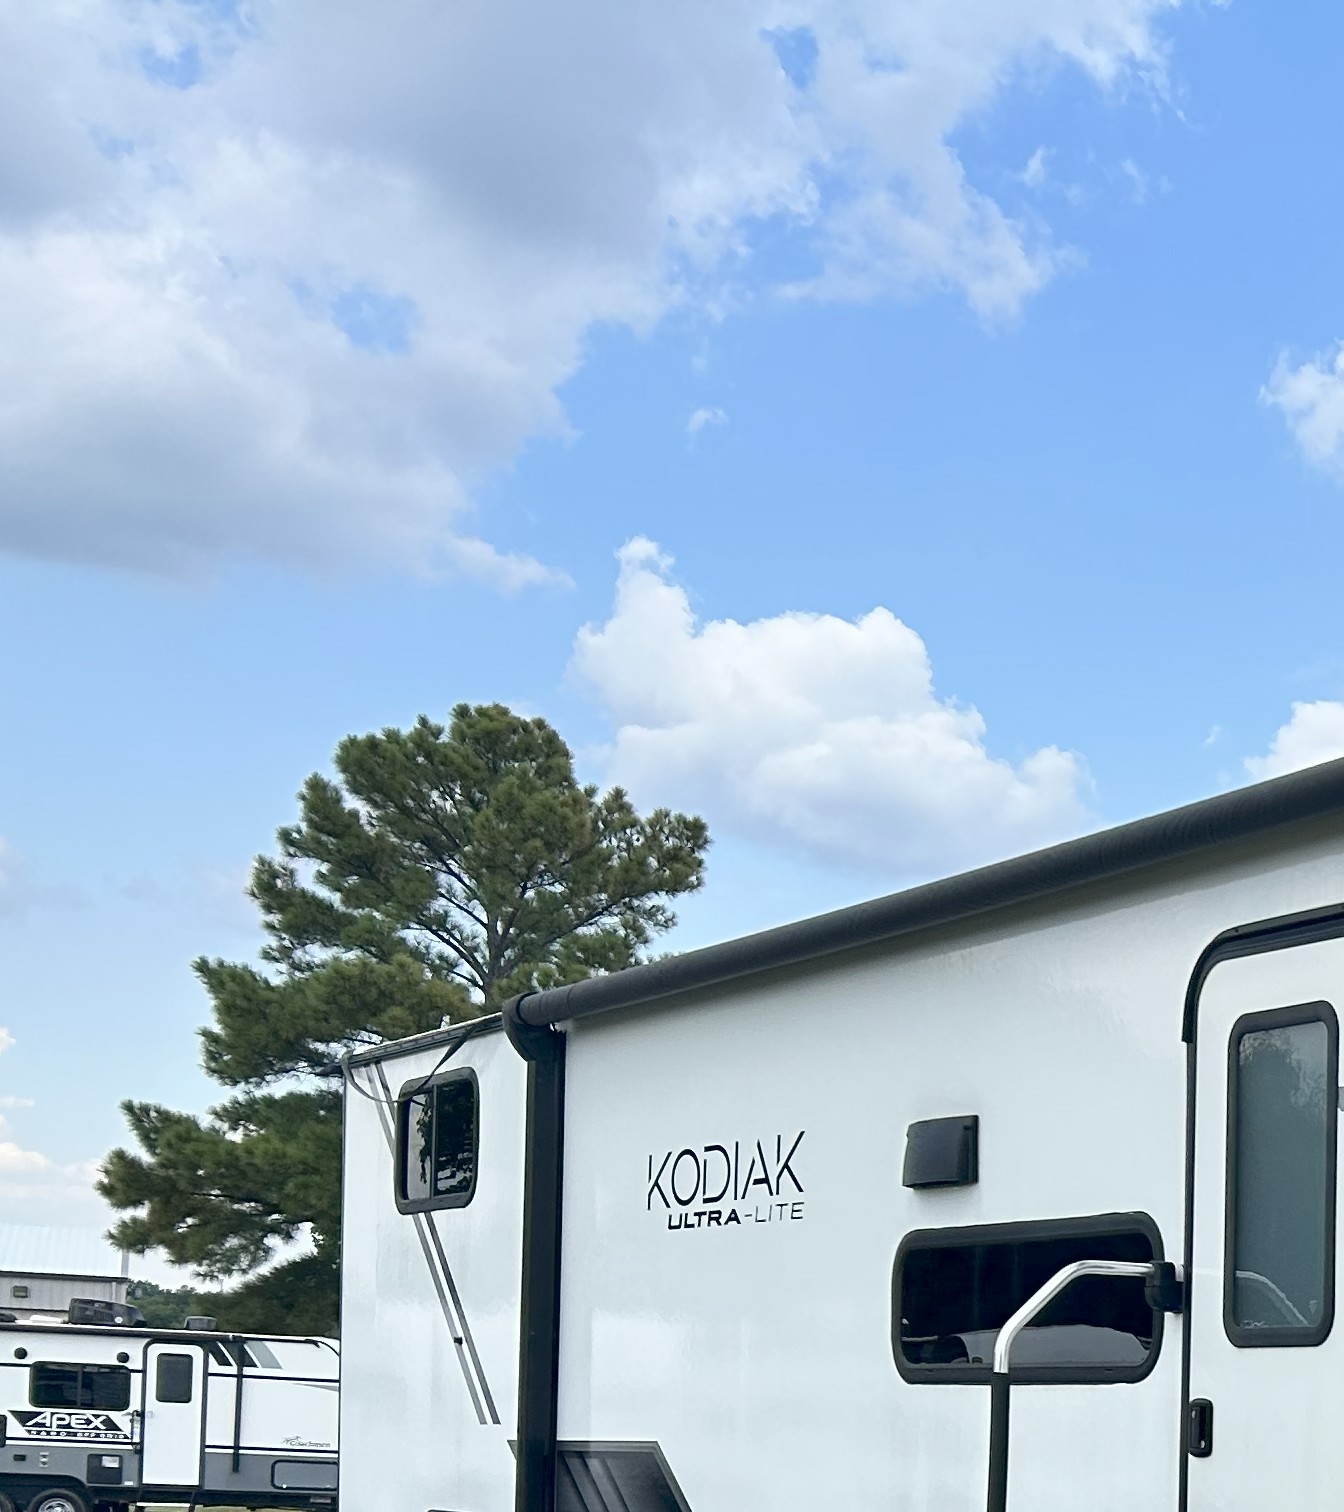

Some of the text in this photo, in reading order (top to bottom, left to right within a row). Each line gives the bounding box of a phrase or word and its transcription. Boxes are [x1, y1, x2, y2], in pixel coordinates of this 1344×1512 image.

[648, 1130, 805, 1211] KODIAK
[667, 1201, 805, 1230] ULTRA-LITE
[25, 1411, 107, 1430] APEX
